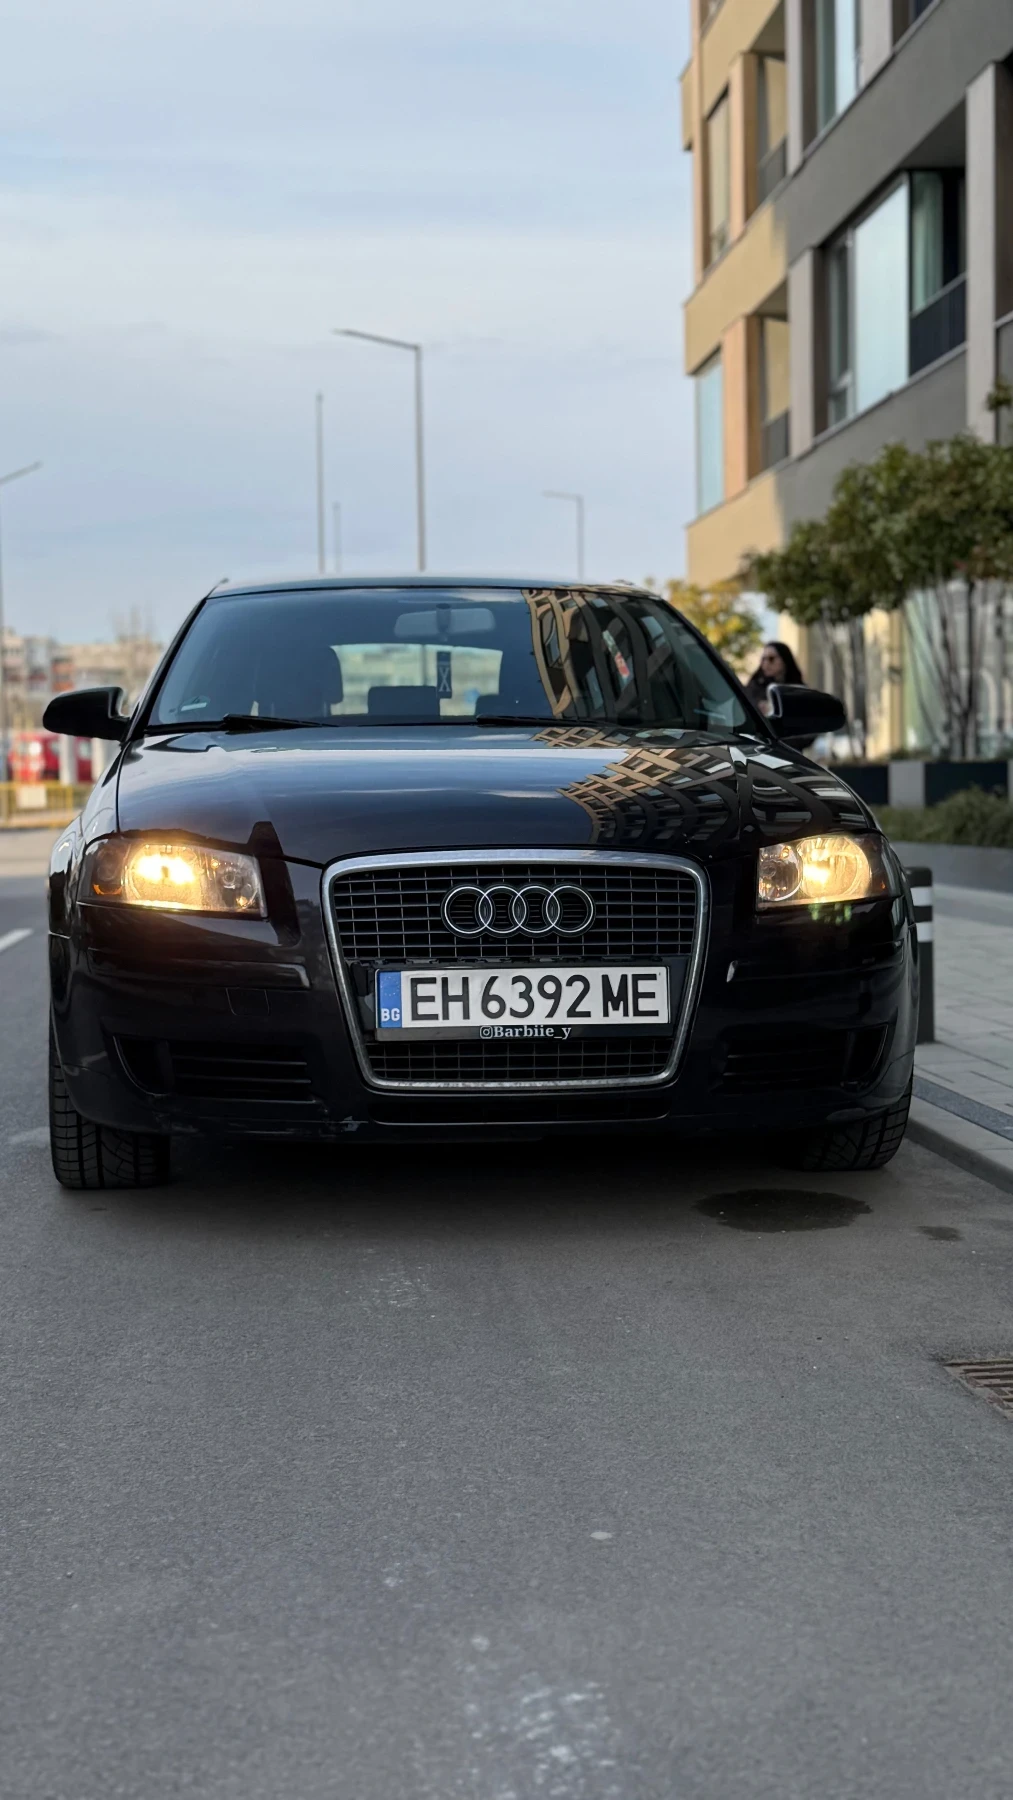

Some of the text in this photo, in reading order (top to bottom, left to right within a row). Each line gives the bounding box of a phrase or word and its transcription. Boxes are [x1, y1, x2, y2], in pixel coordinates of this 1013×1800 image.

[410, 973, 660, 1021] EH 6392 ME
[380, 1008, 400, 1022] BG
